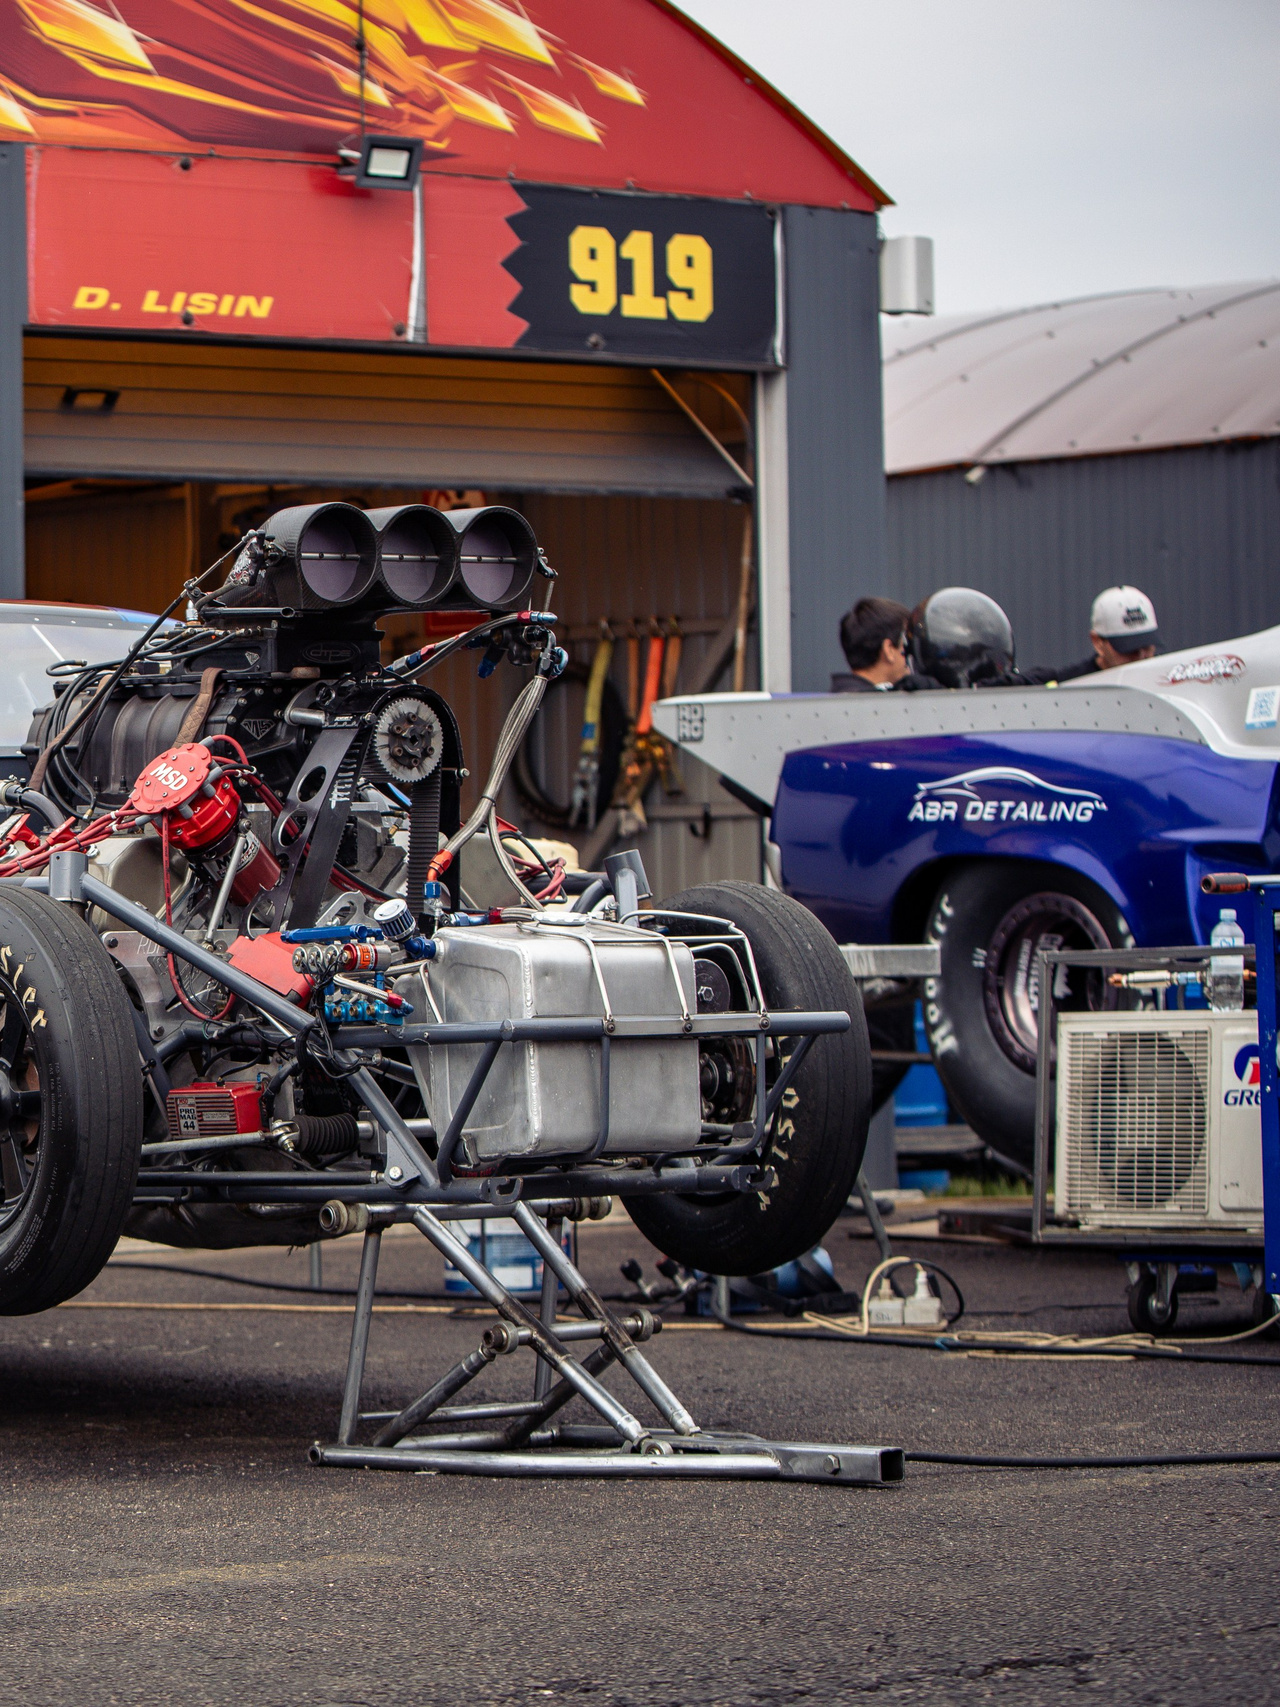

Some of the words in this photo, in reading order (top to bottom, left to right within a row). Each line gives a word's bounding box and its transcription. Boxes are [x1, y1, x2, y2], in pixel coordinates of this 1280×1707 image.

[568, 226, 714, 323] 919
[73, 287, 121, 311] D.
[141, 290, 274, 318] LISIN
[149, 762, 189, 791] MSD
[907, 801, 958, 822] ABR
[964, 801, 1094, 822] DETAILING
[182, 1121, 196, 1130] 44
